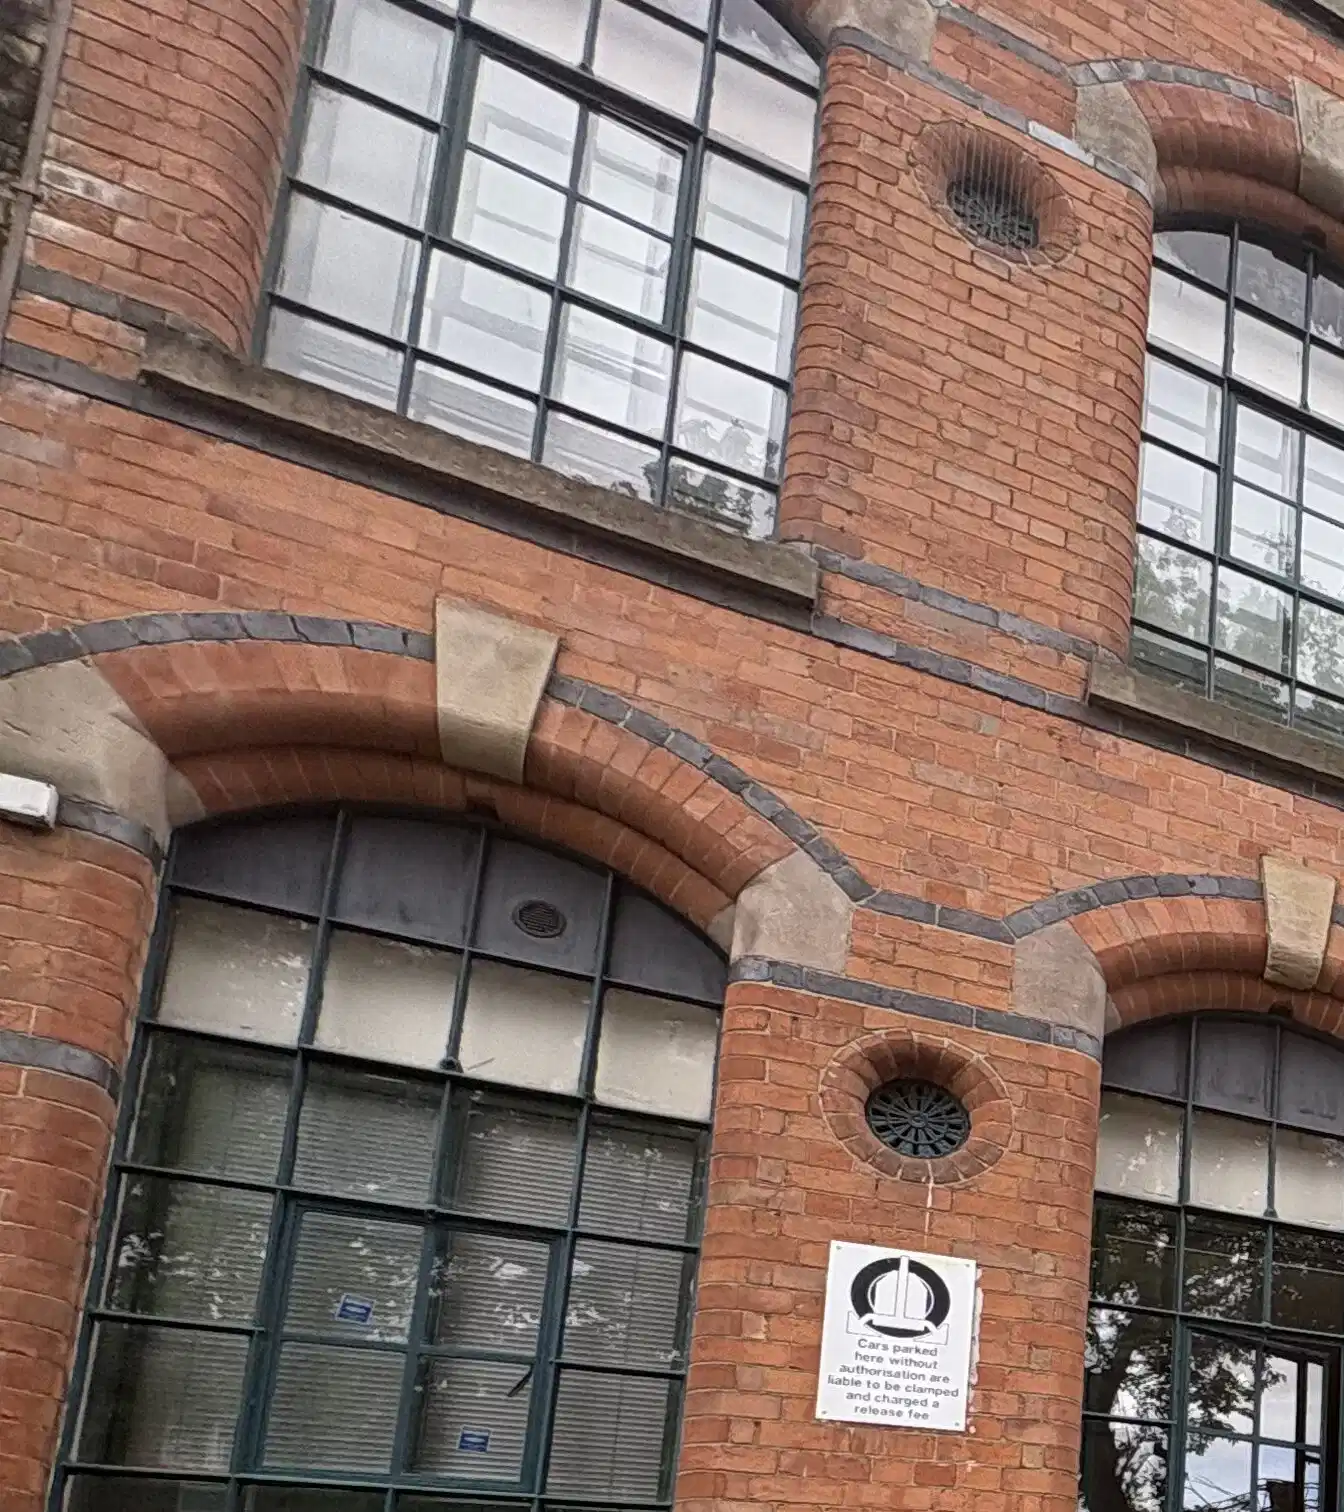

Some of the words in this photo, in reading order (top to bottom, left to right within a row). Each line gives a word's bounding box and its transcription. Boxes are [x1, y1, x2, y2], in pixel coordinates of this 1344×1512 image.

[857, 1338, 889, 1351] Cars
[892, 1344, 938, 1357] parked
[854, 1351, 884, 1363] here
[889, 1356, 938, 1369] without
[839, 1365, 926, 1381] authorisation
[929, 1375, 950, 1383] are
[827, 1374, 862, 1387] liable
[866, 1380, 881, 1389] to
[884, 1381, 901, 1391] be
[904, 1384, 960, 1397] clamped
[845, 1392, 871, 1401] and
[874, 1394, 928, 1407] charged
[853, 1406, 904, 1417] release
[907, 1409, 930, 1420] fee
